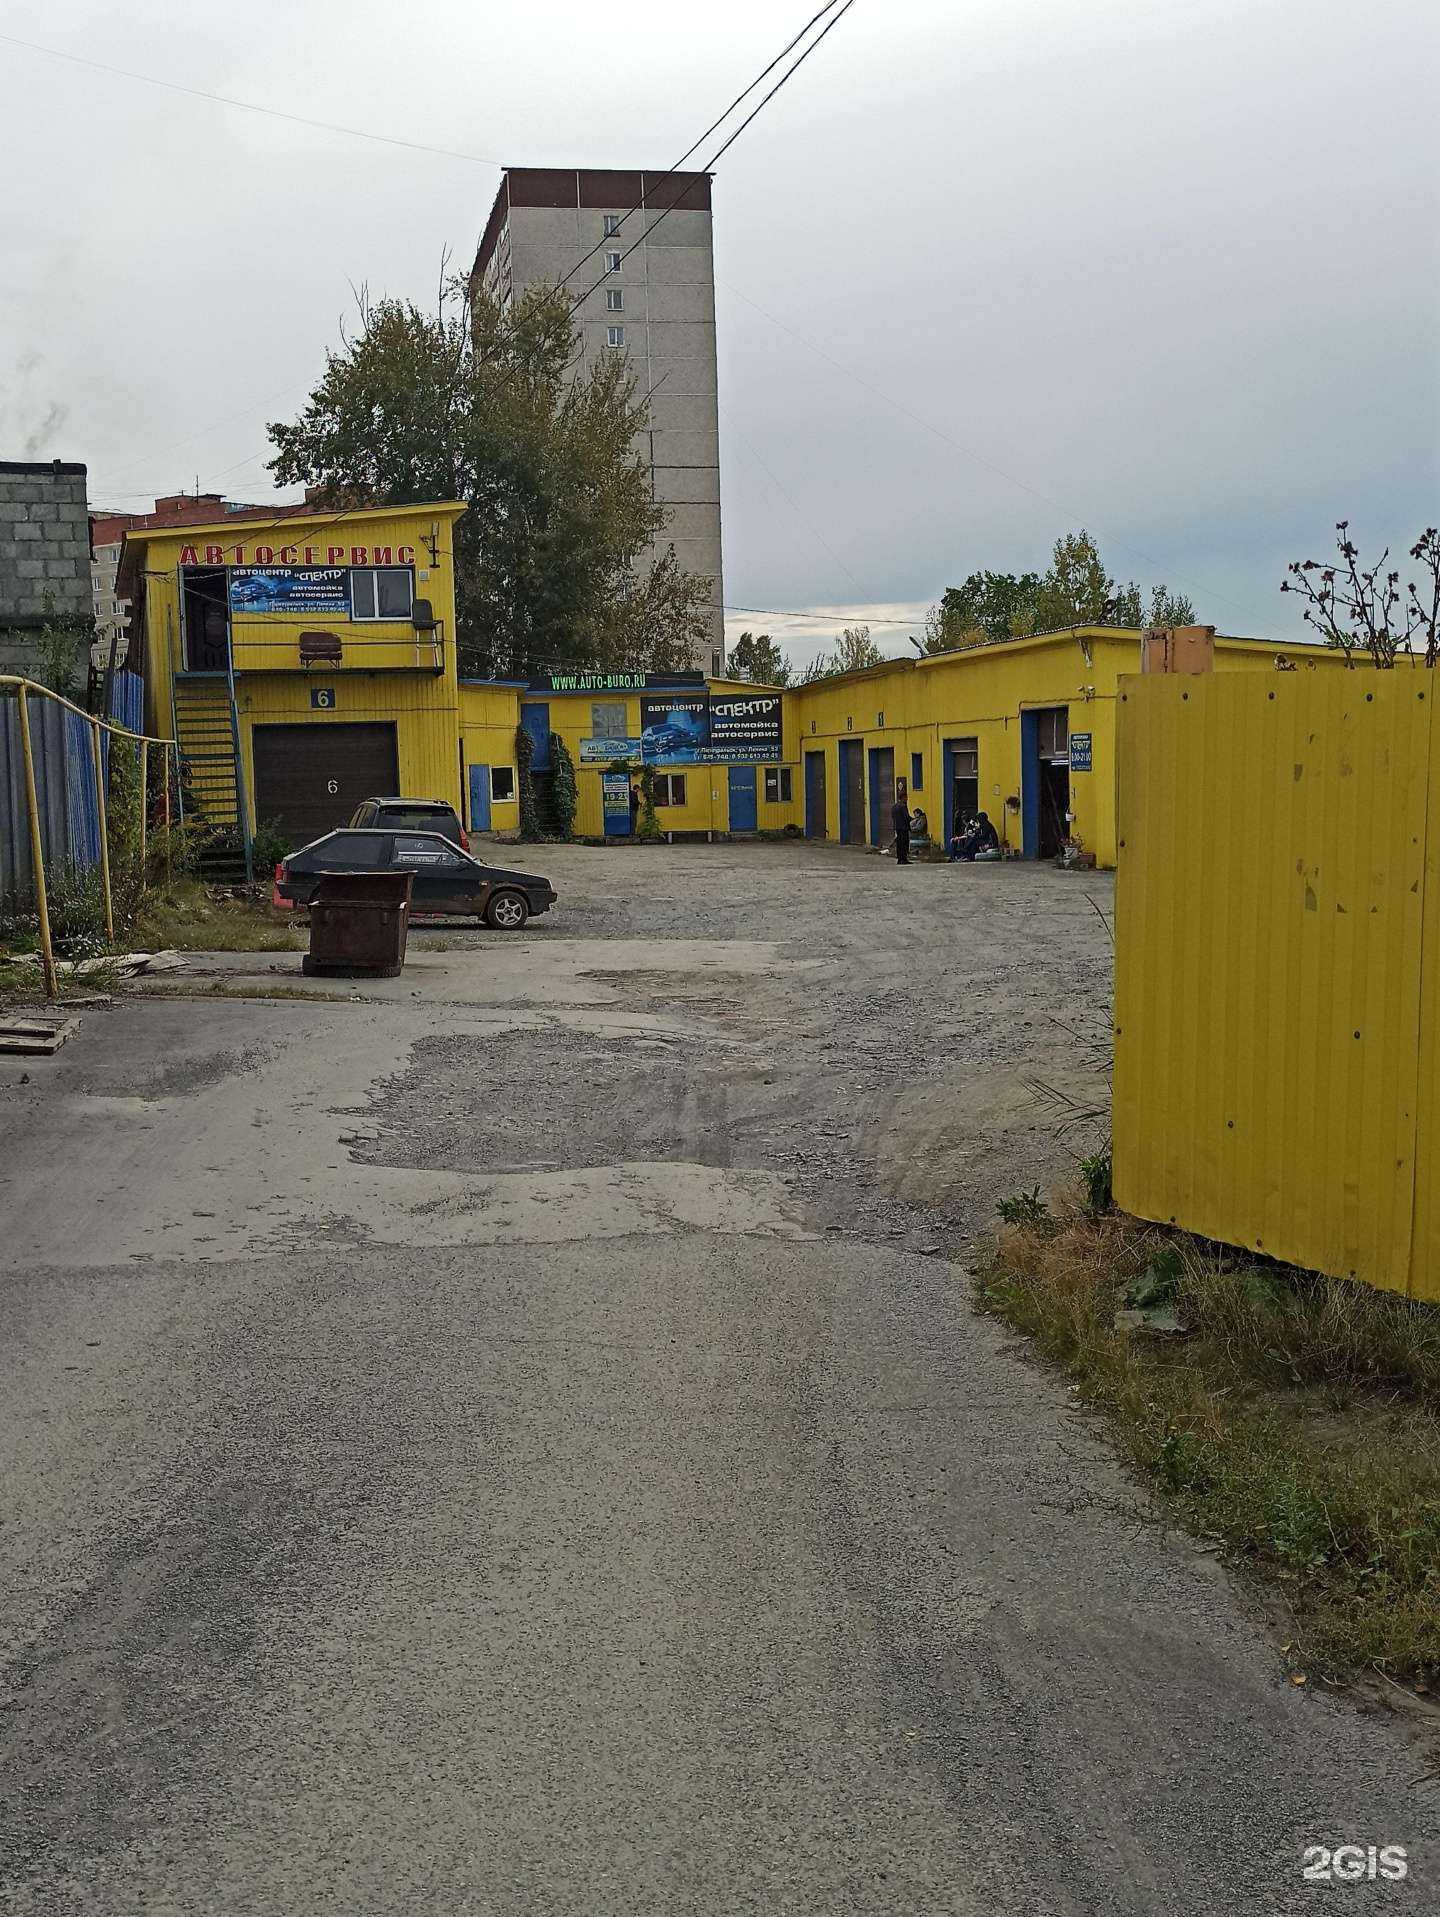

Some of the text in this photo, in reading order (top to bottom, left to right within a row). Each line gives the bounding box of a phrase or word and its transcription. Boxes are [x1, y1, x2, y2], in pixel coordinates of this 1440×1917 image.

[179, 544, 416, 566] АВТОСЕРВИС
[233, 569, 292, 577] автоцентр
[551, 674, 646, 690] WWW.AUTO-BURO.RU
[317, 690, 329, 707] 6
[648, 704, 703, 712] автоцентр
[327, 780, 338, 794] 6
